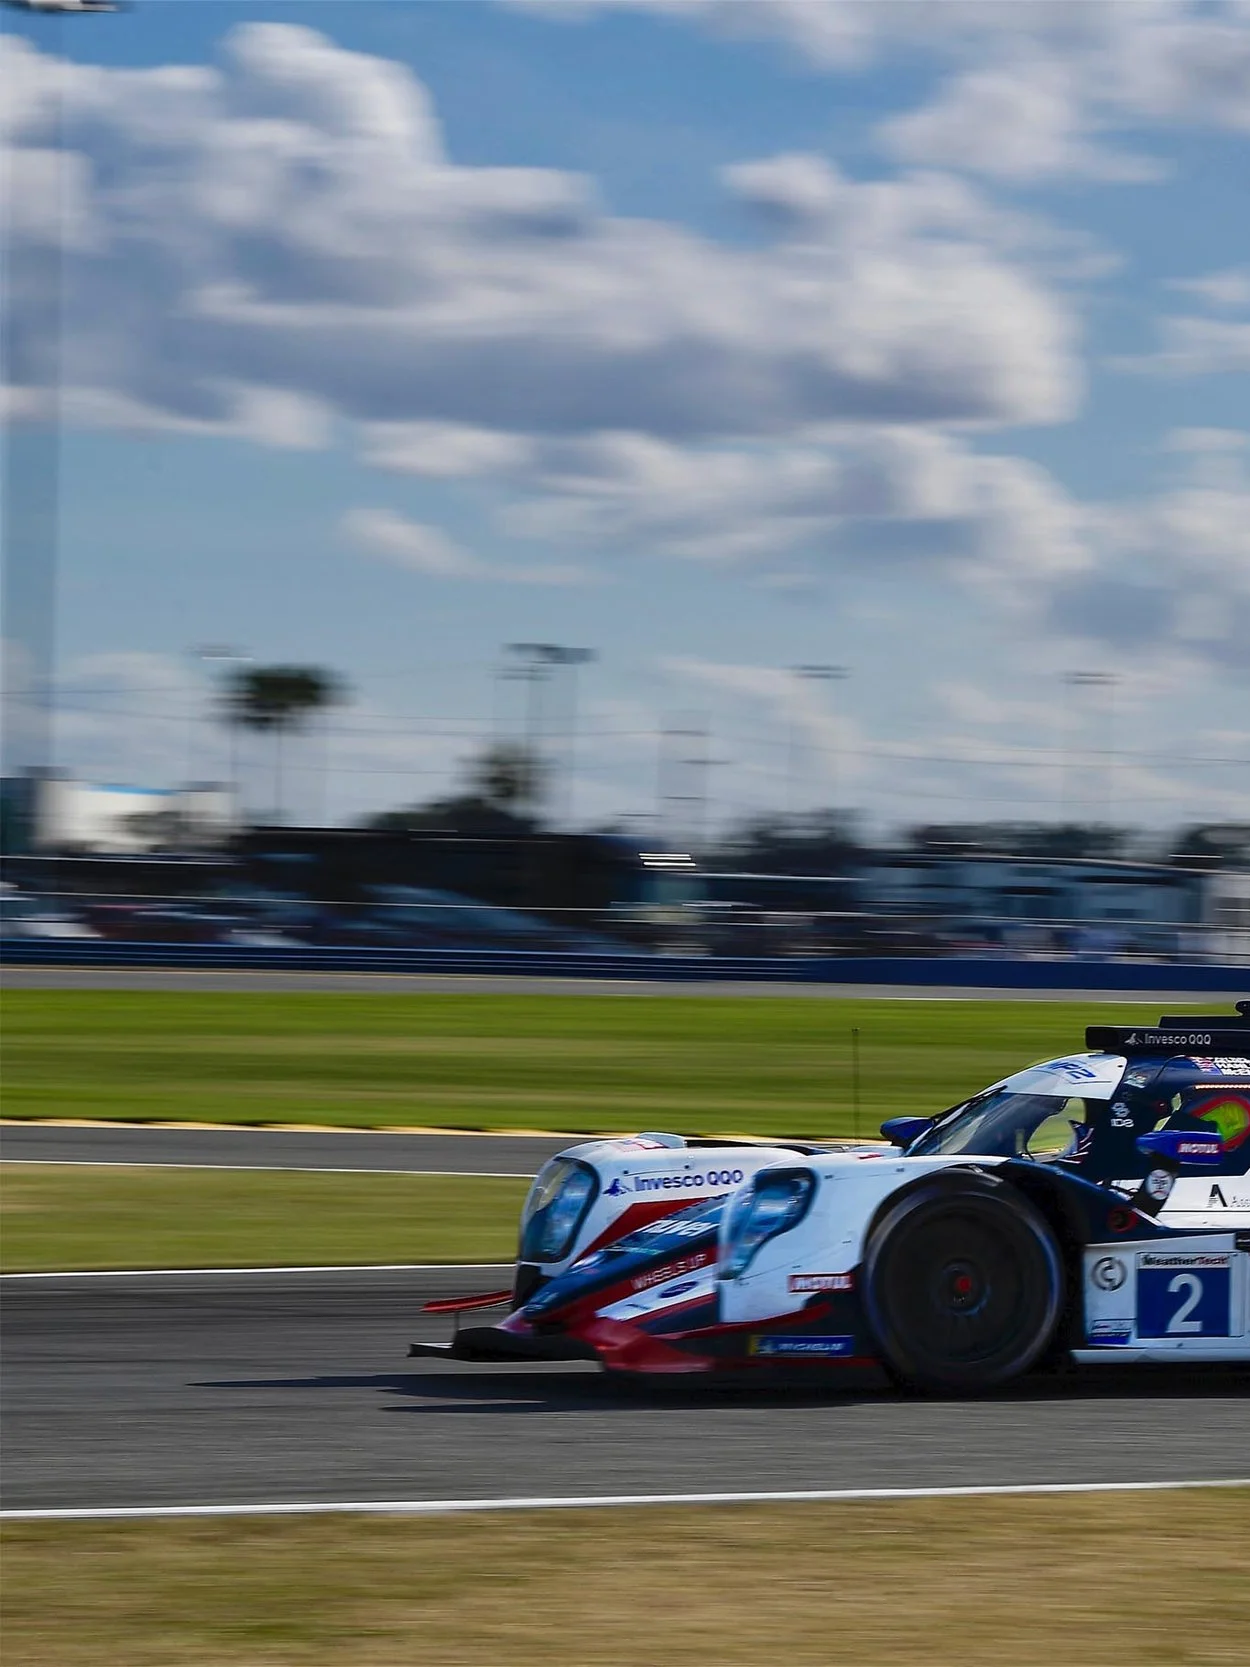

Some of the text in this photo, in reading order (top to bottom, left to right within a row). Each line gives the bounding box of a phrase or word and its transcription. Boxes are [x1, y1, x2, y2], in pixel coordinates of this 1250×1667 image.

[1144, 1034, 1211, 1045] Invesco QQQ
[1178, 1143, 1219, 1154] MOTUL
[634, 1174, 704, 1191] Invesco
[1142, 1254, 1230, 1266] WeatherTech
[630, 1261, 687, 1290] WHEELS
[791, 1276, 852, 1290] MOTUL
[1165, 1273, 1203, 1333] 2
